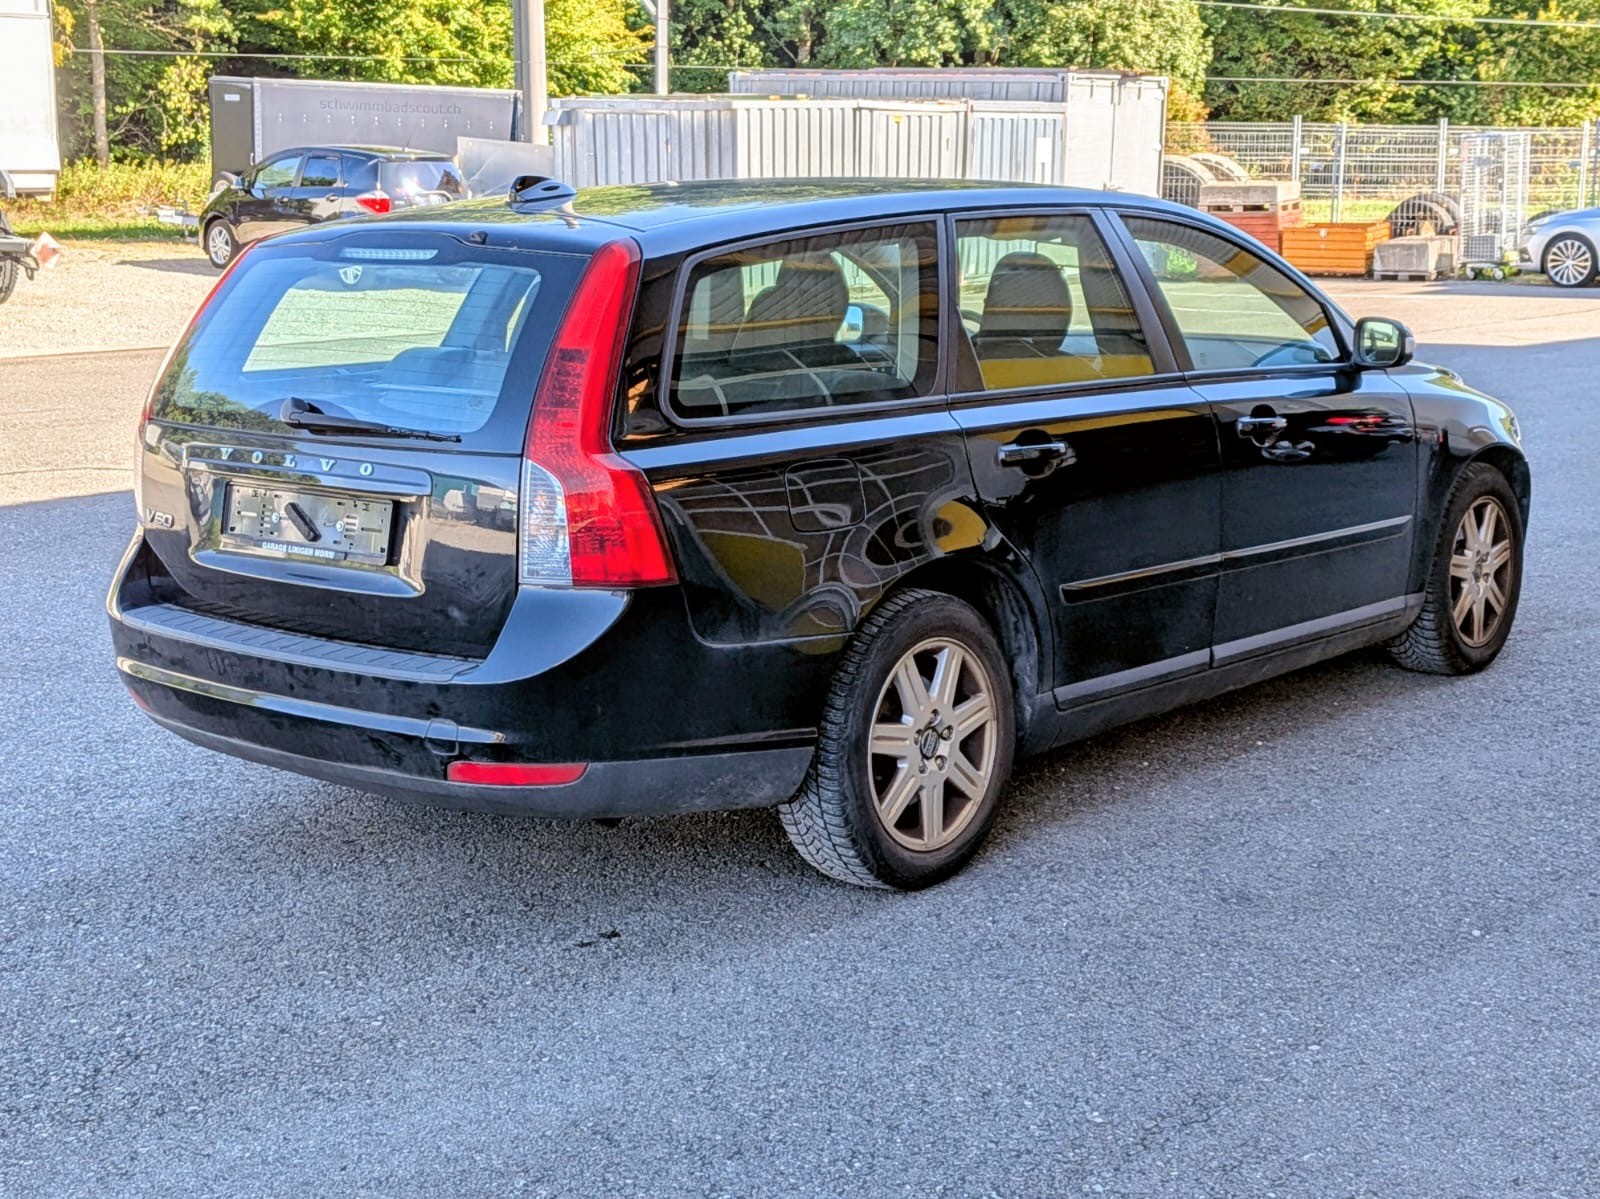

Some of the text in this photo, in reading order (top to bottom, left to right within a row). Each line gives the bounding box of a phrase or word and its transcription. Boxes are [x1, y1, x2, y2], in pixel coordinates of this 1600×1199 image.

[319, 97, 463, 116] schwimmbadscout.ch
[220, 447, 373, 475] VOLVO
[146, 508, 174, 528] V50
[262, 541, 287, 552] GARAGE
